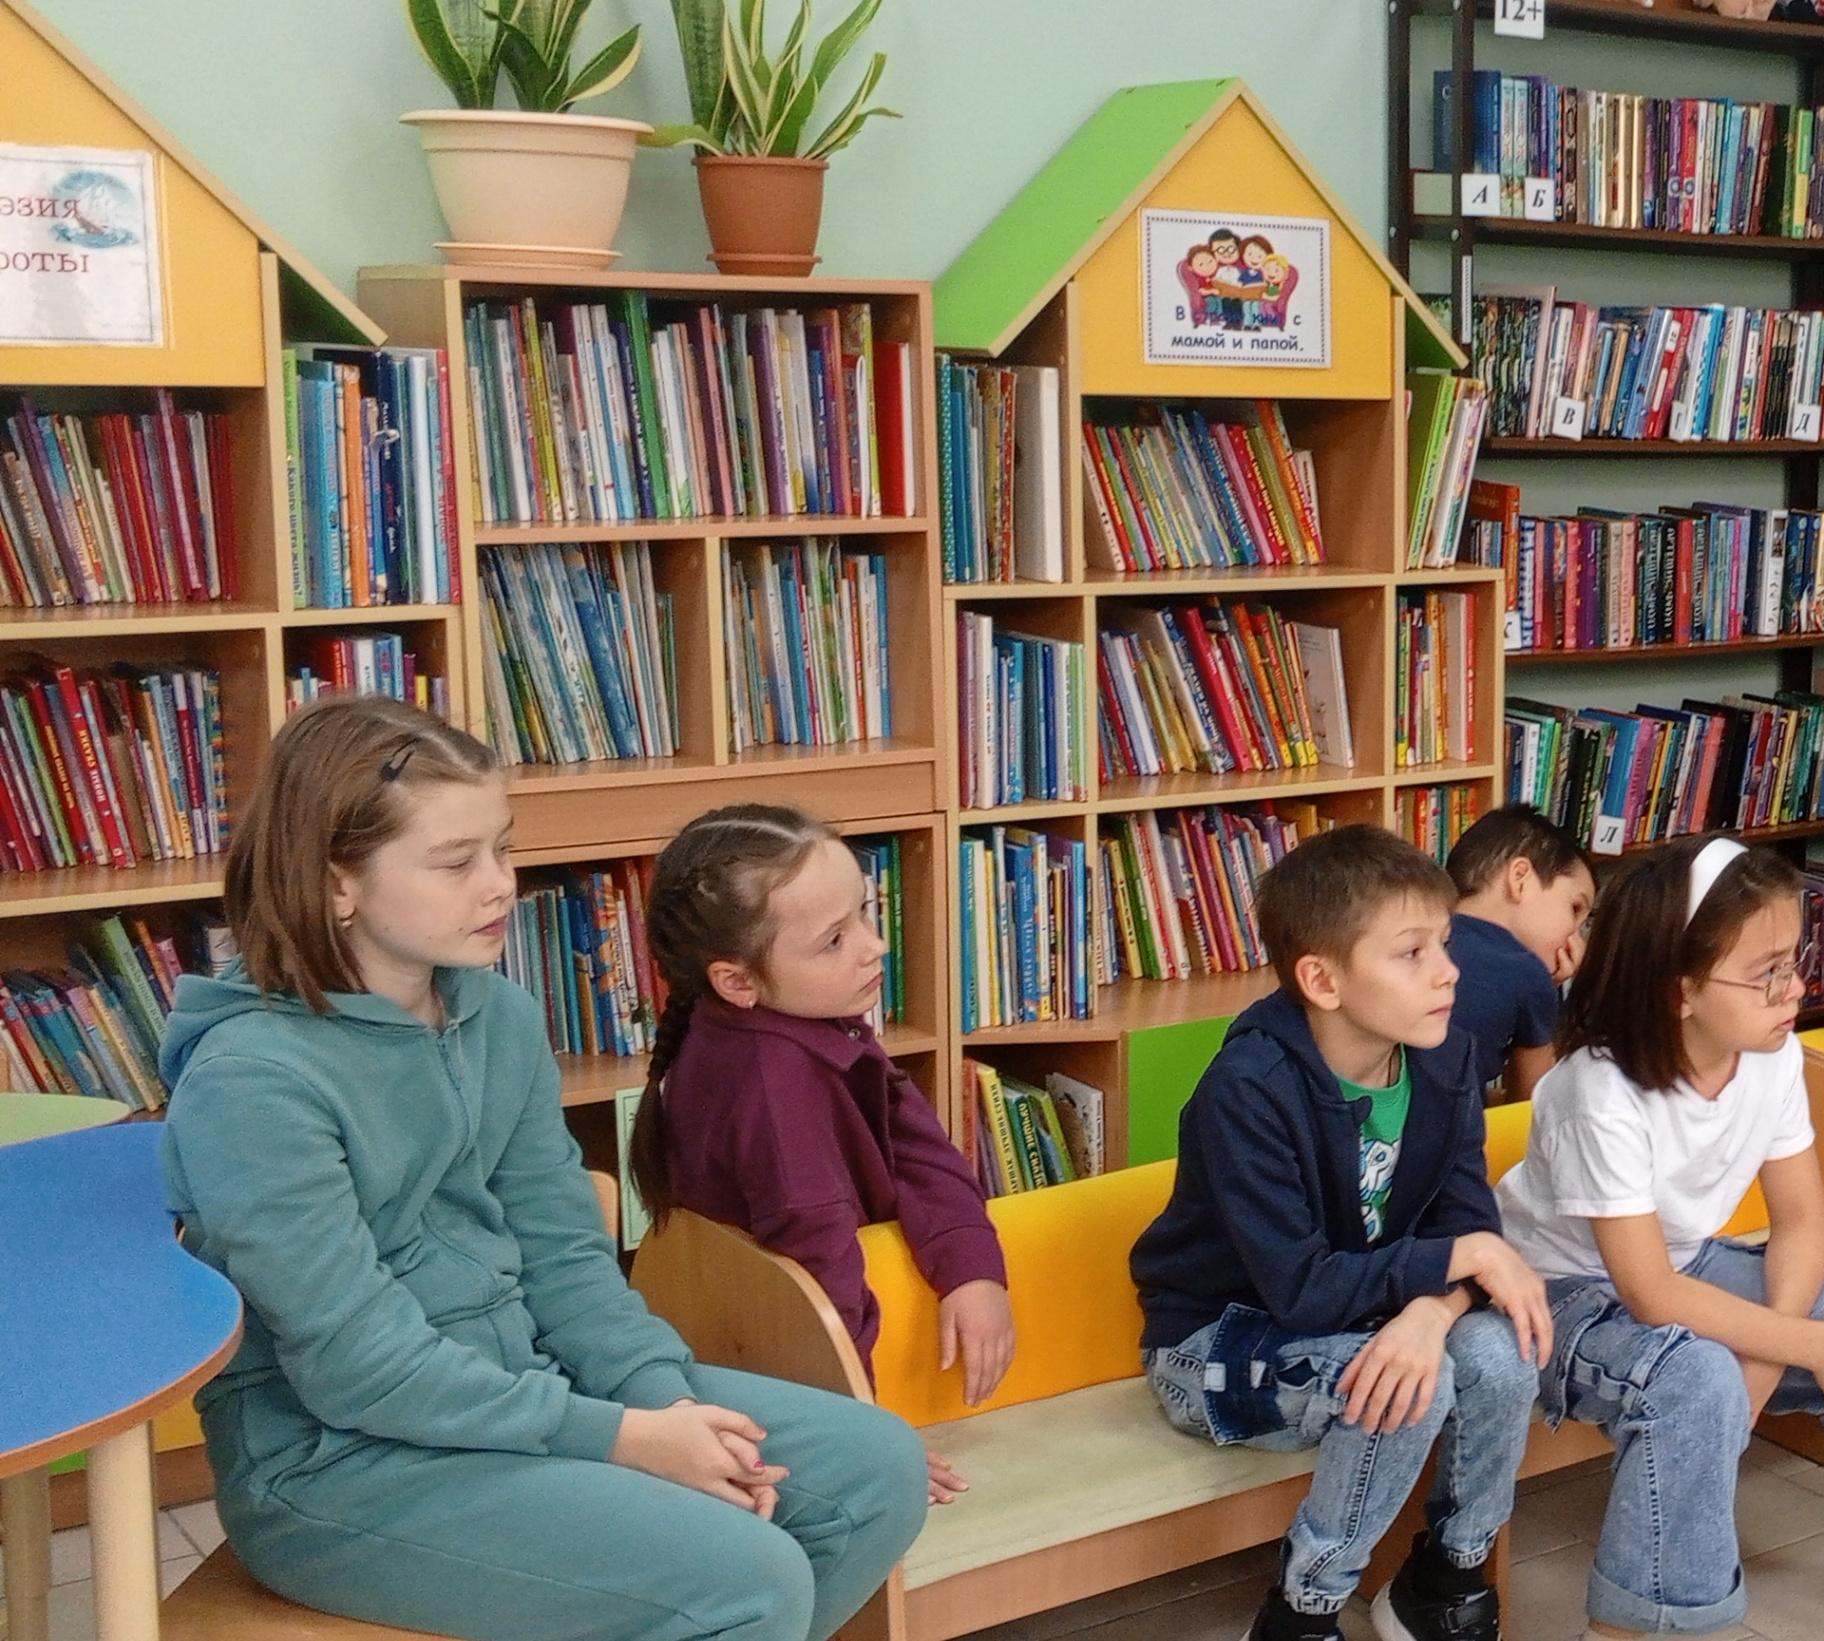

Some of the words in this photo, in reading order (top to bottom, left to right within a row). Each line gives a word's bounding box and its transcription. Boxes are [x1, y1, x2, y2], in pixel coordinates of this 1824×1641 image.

[1500, 0, 1543, 21] 12+
[1471, 184, 1488, 205] А
[1532, 189, 1546, 208] Б
[1175, 306, 1186, 321] В
[1171, 333, 1226, 348] мамой
[1232, 338, 1243, 349] и
[1250, 335, 1304, 352] папой.
[1562, 407, 1576, 425] В
[1795, 413, 1811, 433] Д
[1600, 826, 1618, 843] Л
[1018, 1103, 1036, 1152] ЛУЧШИЕ
